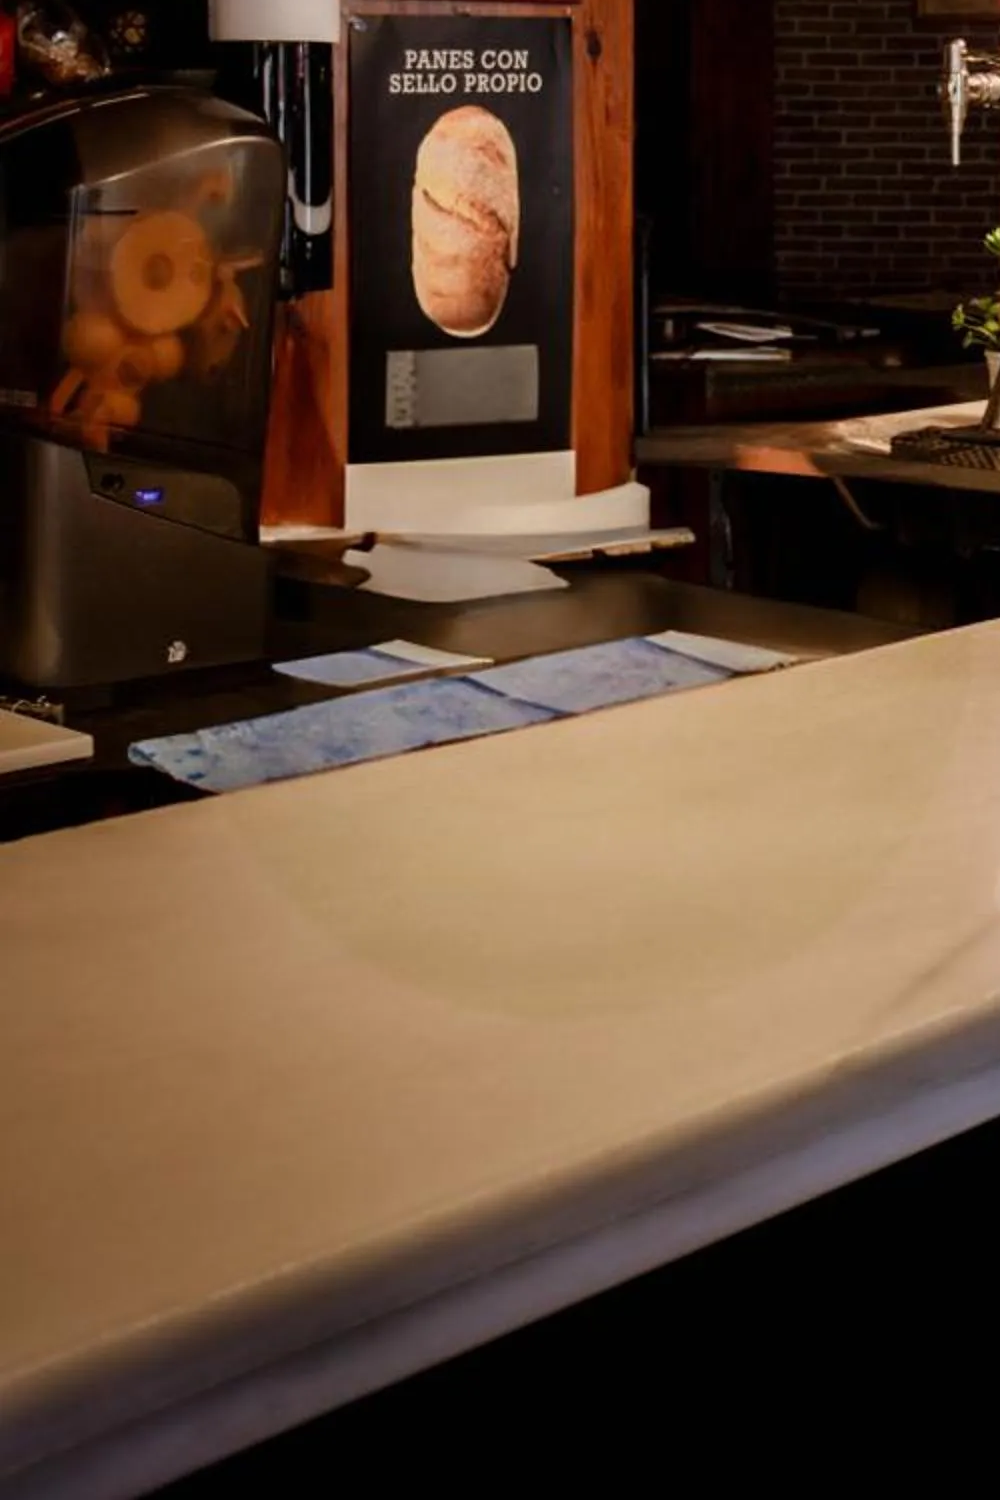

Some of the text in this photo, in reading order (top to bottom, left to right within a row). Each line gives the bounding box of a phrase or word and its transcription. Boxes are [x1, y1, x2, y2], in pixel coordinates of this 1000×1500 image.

[404, 49, 529, 70] PANES CON
[388, 72, 543, 94] SELLO PROPIO
